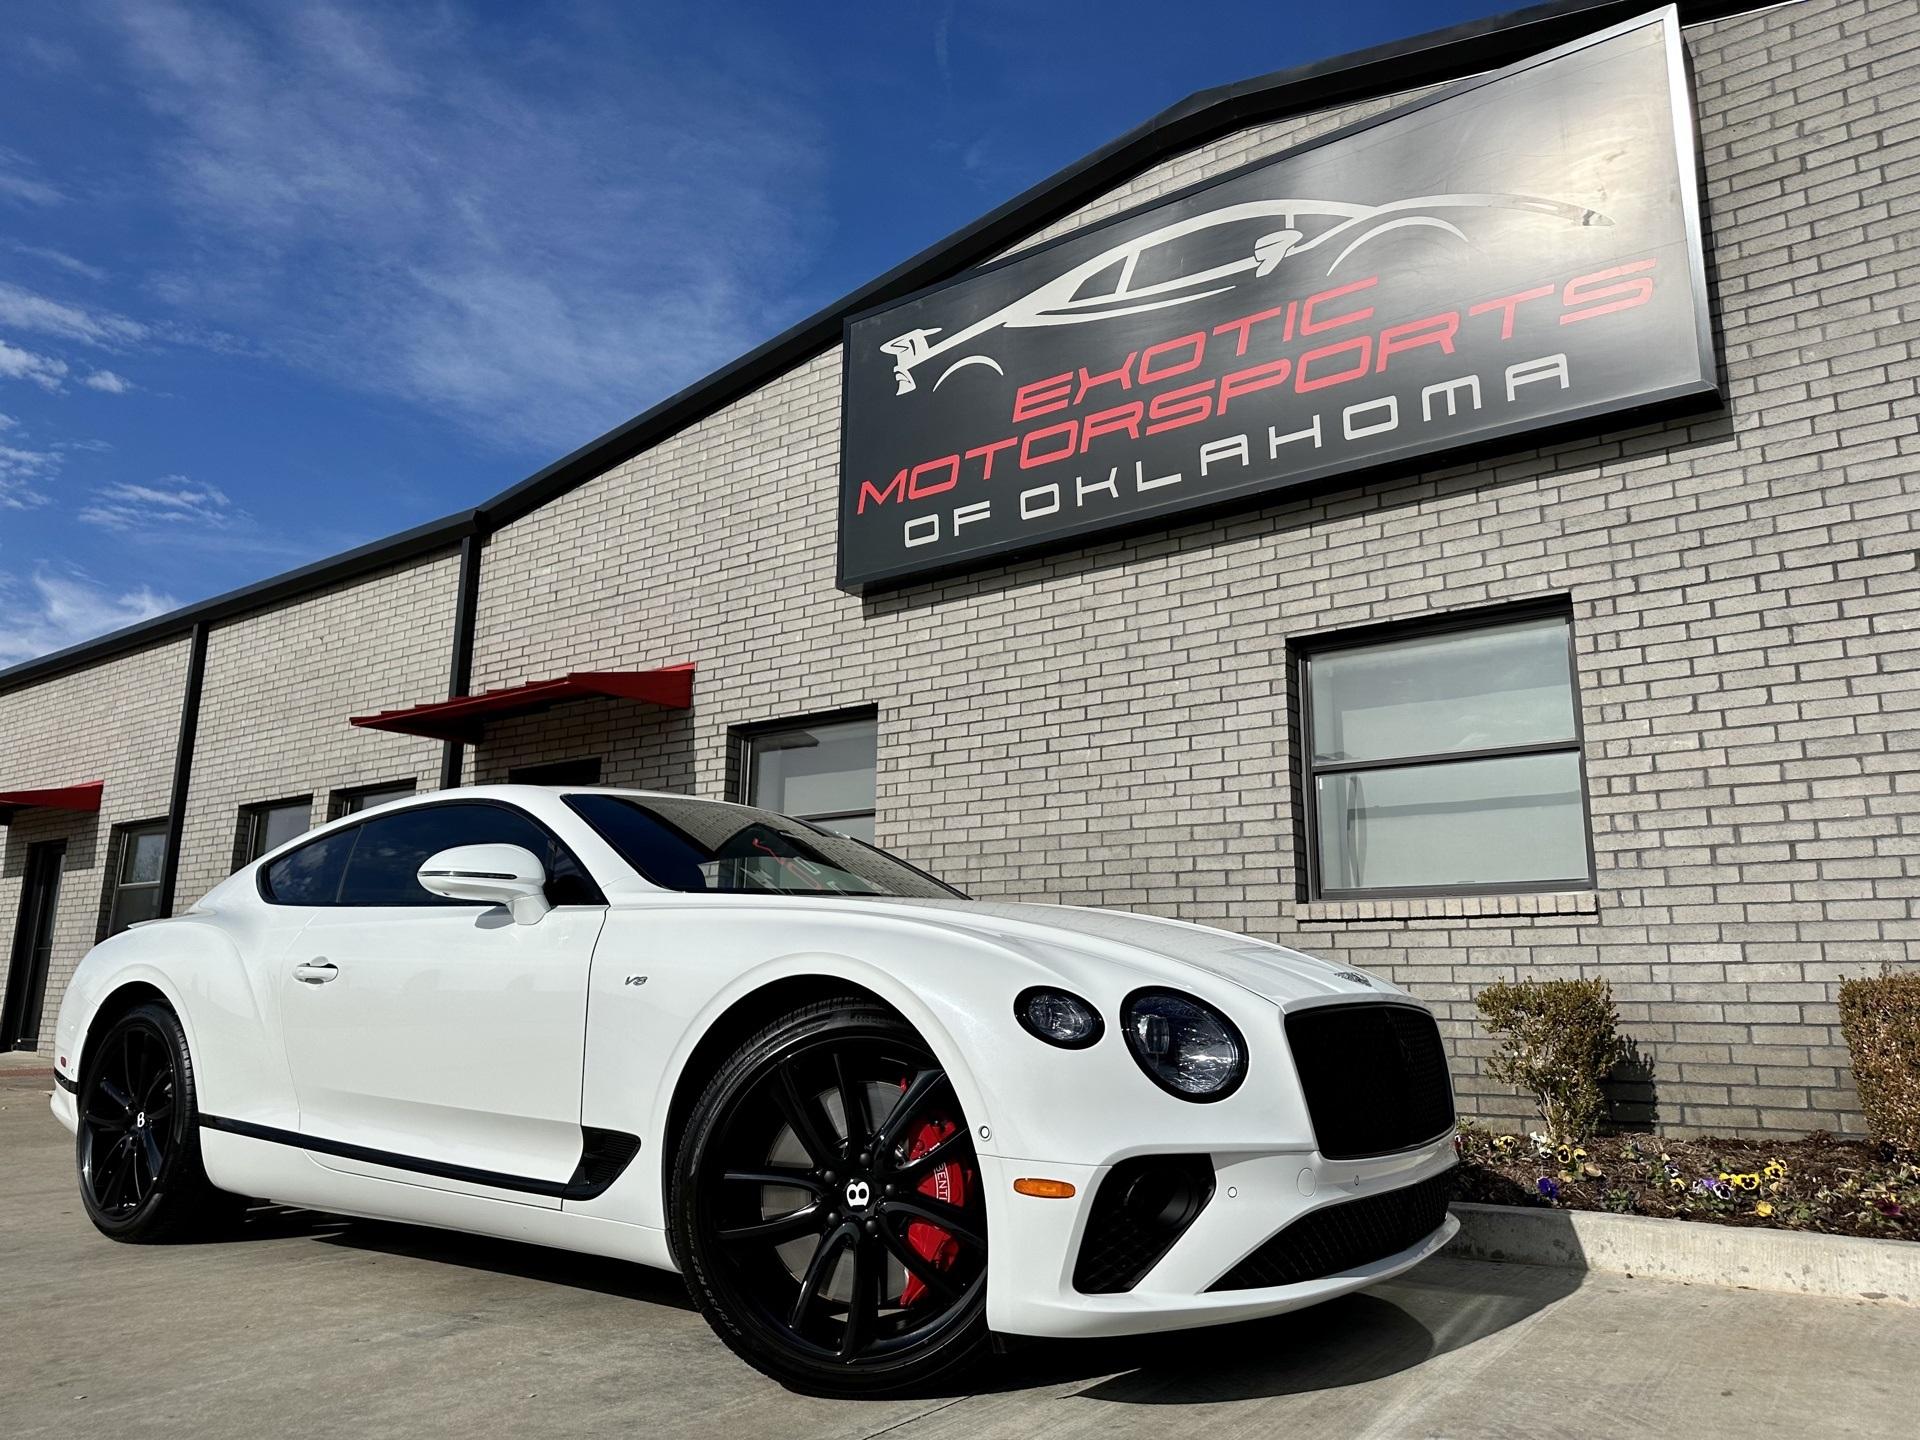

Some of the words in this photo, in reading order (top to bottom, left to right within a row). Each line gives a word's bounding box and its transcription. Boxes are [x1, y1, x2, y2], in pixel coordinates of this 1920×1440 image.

[856, 257, 1657, 514] MOTORSPORTS
[1012, 276, 1378, 423] EXOTIC
[904, 500, 991, 548] OF
[1019, 353, 1570, 521] OKLAHOMA
[624, 975, 648, 986] V8
